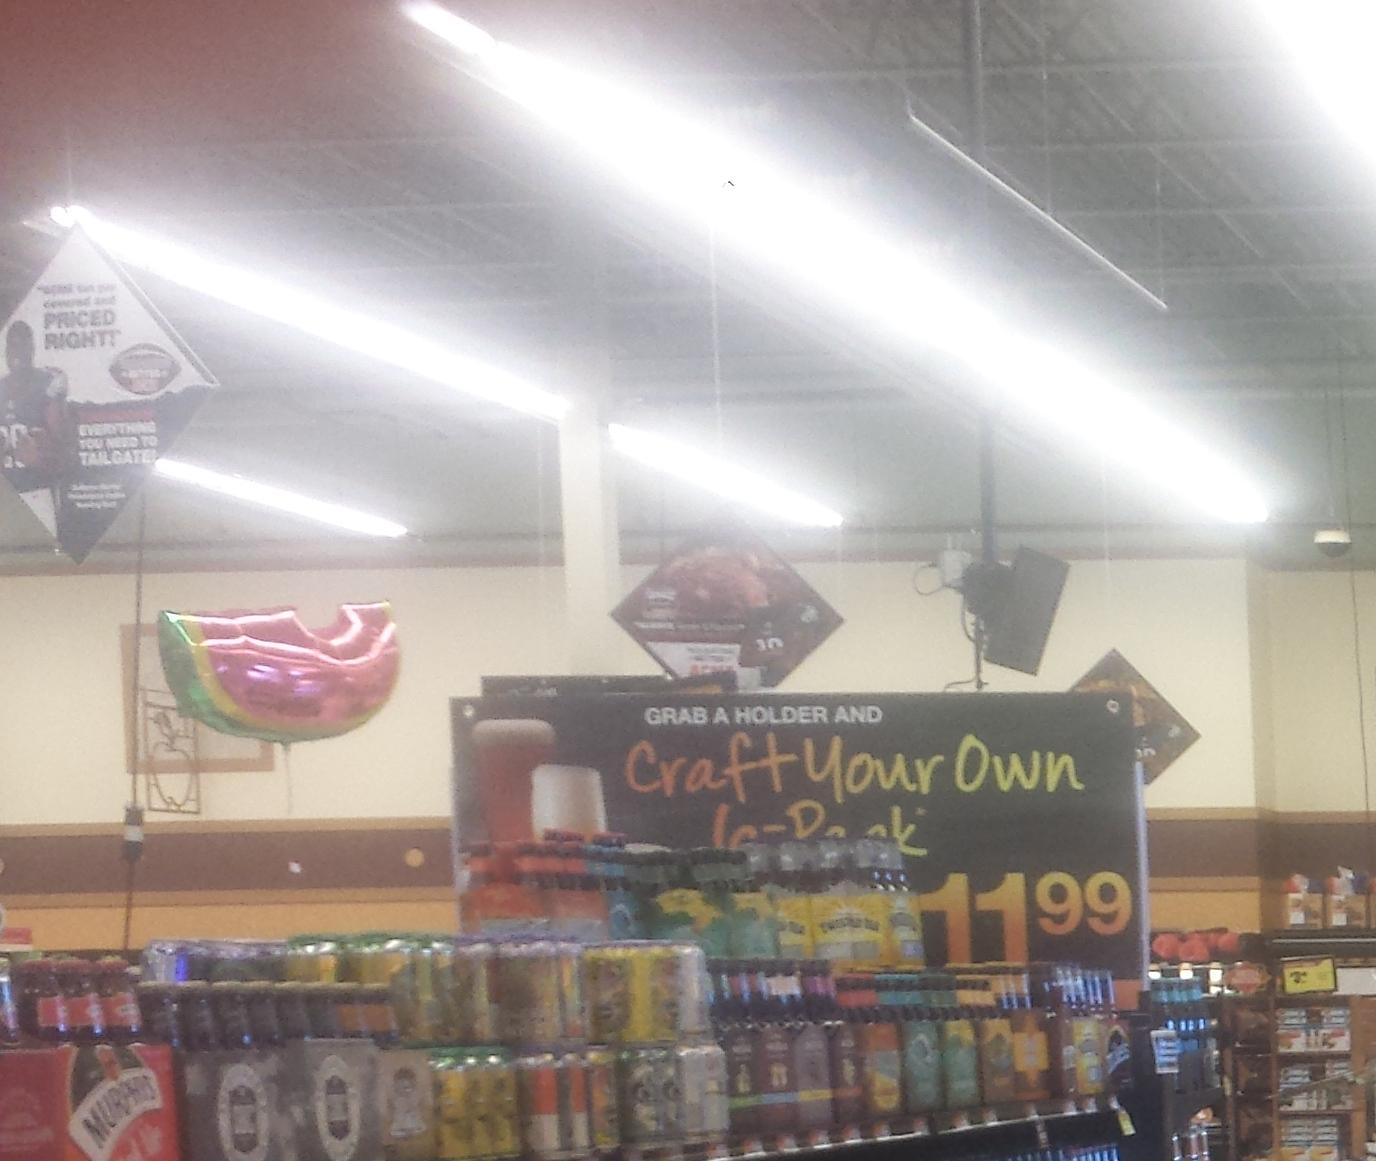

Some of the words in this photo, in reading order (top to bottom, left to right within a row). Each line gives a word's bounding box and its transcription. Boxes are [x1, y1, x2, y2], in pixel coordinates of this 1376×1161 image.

[43, 310, 116, 330] PRICED
[644, 706, 709, 726] GRAB
[712, 706, 730, 725] A
[734, 704, 828, 726] HOLDER
[835, 703, 883, 724] AND
[625, 730, 799, 801] Craft
[802, 733, 944, 800] Your
[955, 733, 1085, 795] Own
